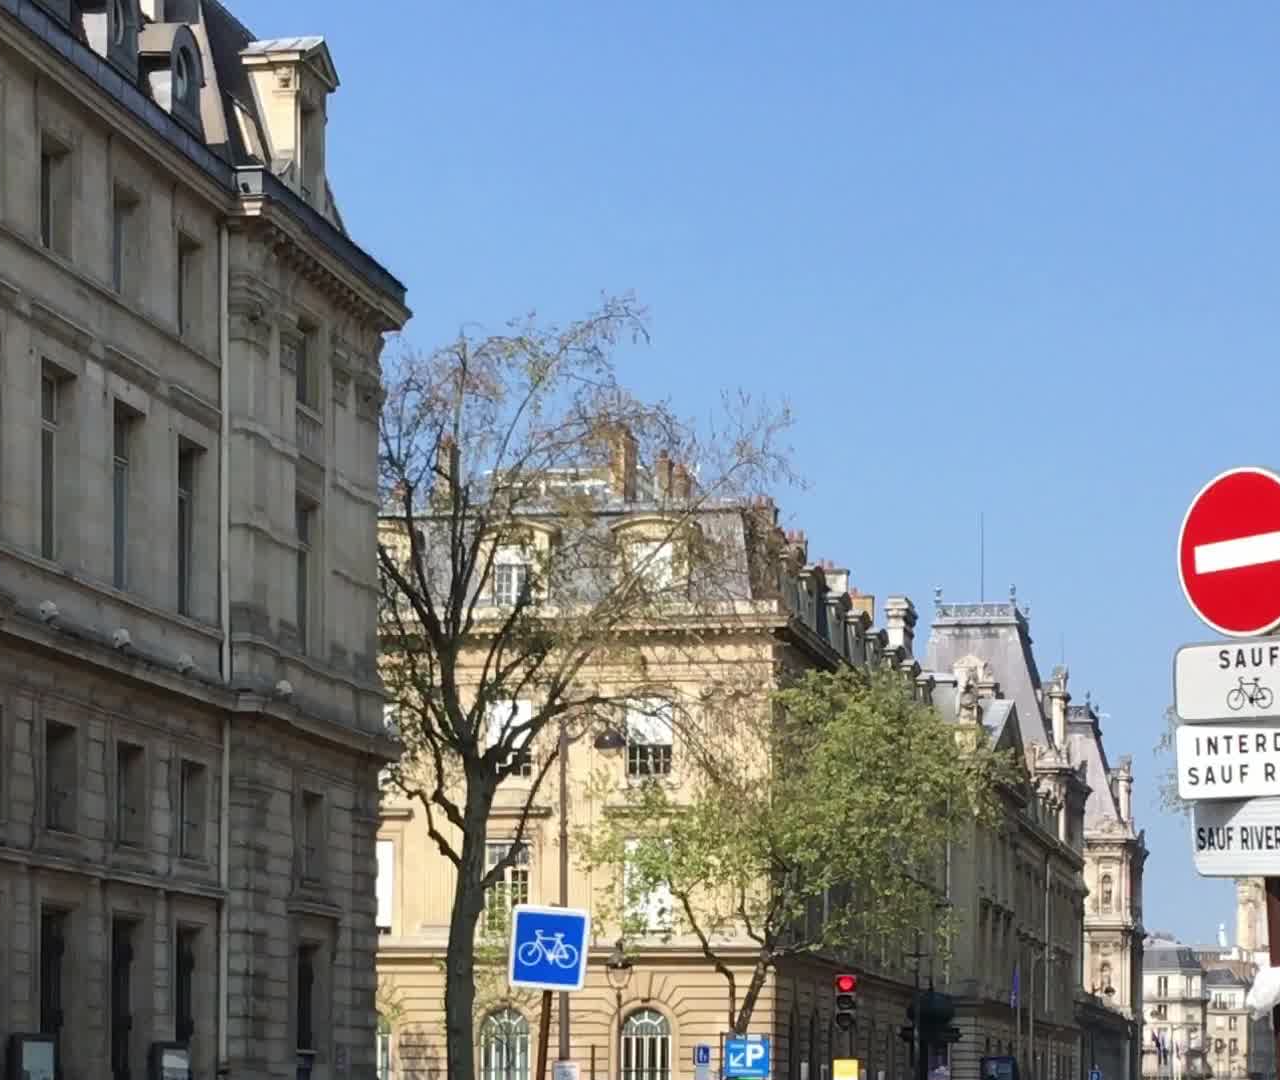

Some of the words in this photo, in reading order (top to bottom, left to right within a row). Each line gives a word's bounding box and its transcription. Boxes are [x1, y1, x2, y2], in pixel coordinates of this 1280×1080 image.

[1219, 646, 1280, 669] SAUF
[1188, 764, 1249, 786] SAUF
[1197, 827, 1234, 850] SAUF
[746, 1045, 765, 1067] P
